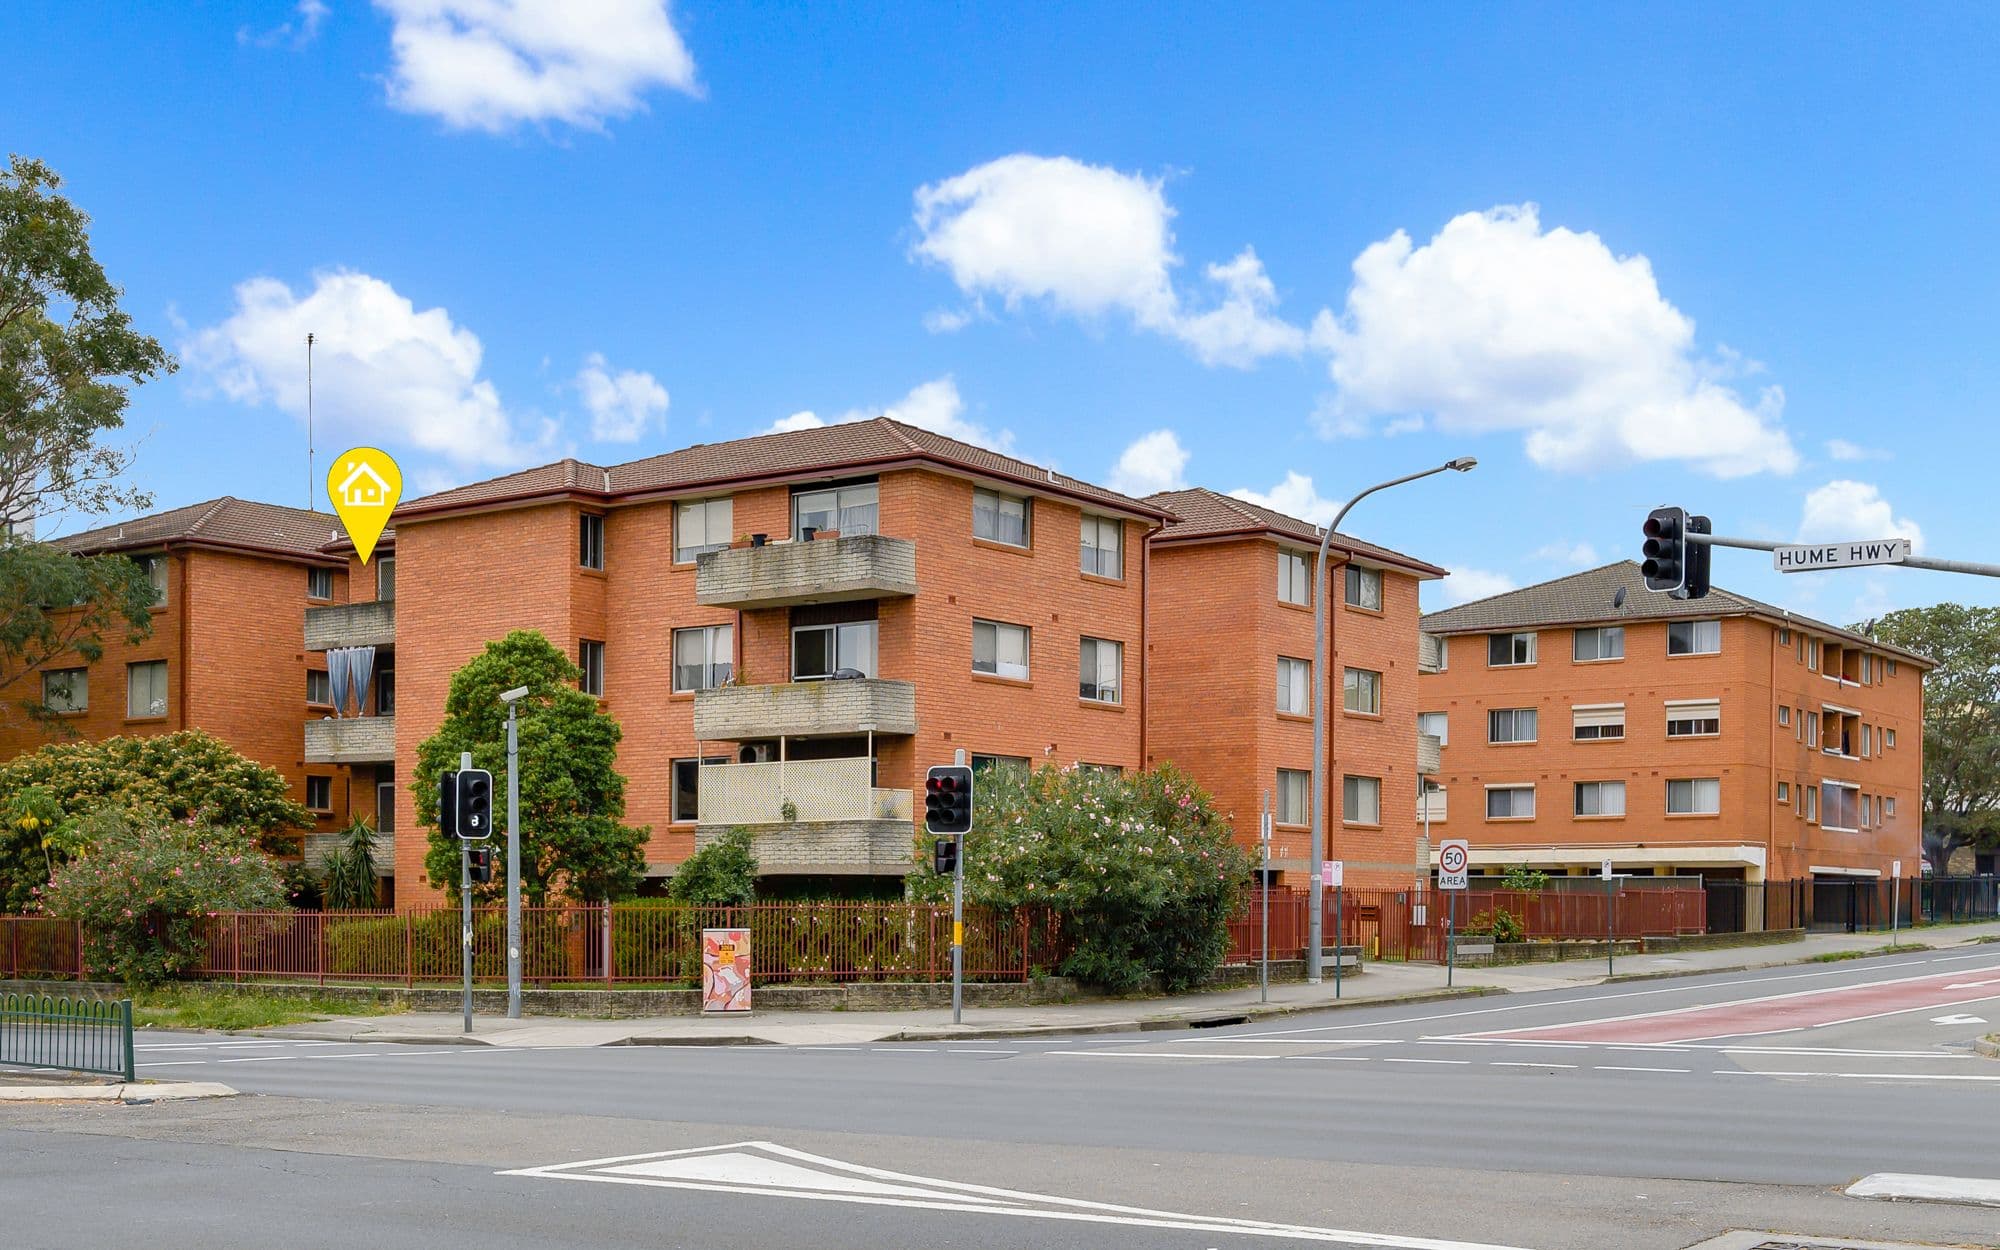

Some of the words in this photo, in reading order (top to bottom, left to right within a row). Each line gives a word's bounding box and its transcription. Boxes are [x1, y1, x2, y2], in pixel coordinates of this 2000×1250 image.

[1780, 548, 1838, 566] HUME
[1850, 543, 1897, 561] HWY
[1445, 852, 1462, 865] 50
[1440, 876, 1466, 886] AREA
